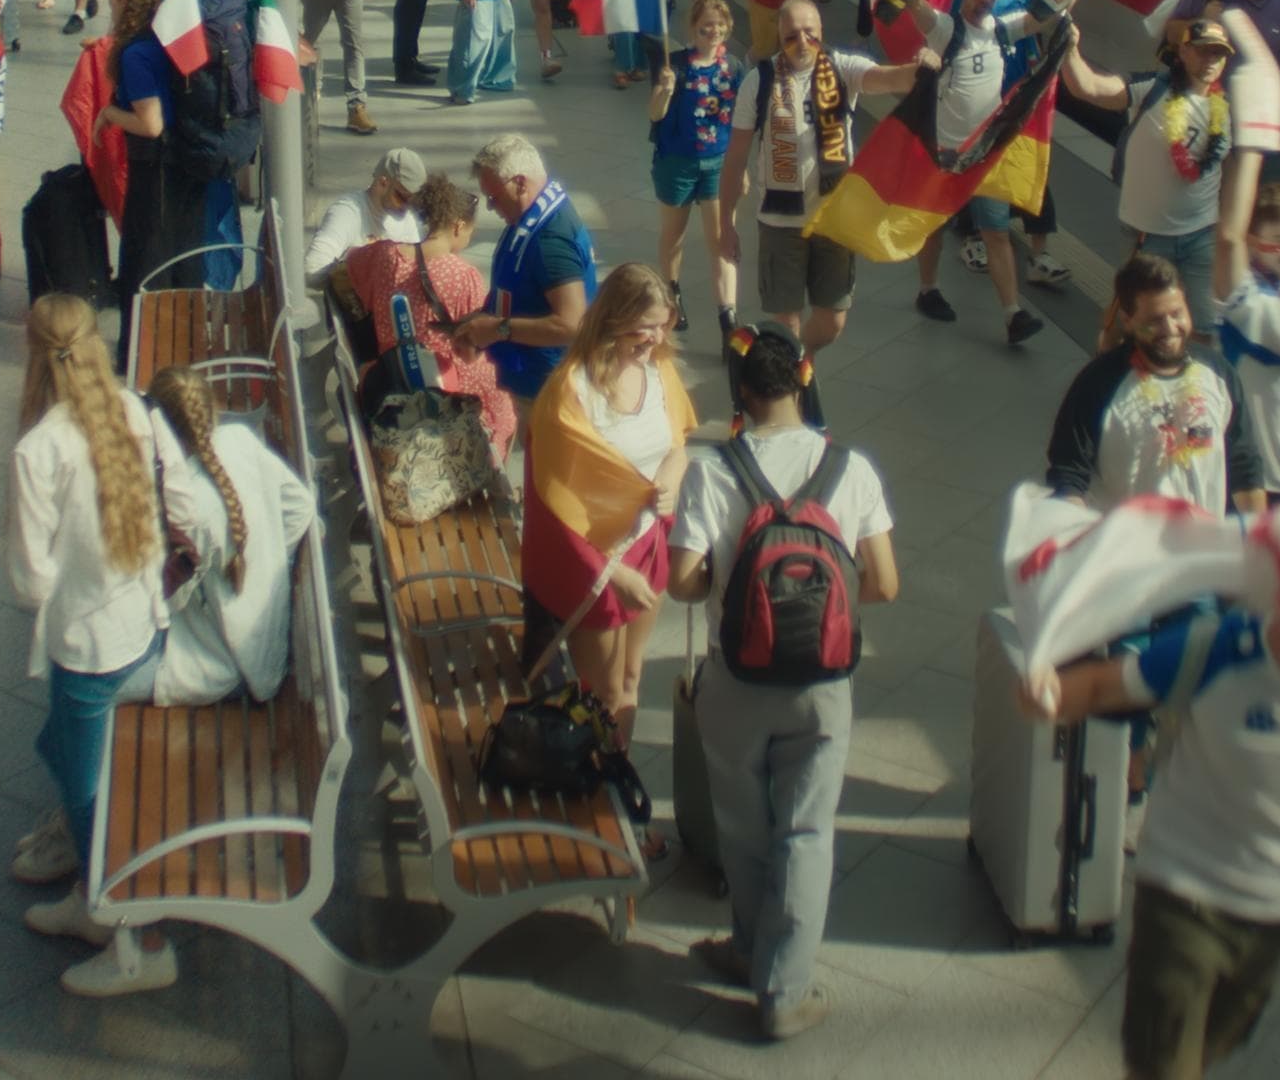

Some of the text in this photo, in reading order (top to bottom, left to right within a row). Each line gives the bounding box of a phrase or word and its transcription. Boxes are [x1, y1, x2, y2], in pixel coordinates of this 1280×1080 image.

[972, 53, 985, 75] 8
[819, 113, 847, 163] AUF
[1186, 126, 1200, 149] 7
